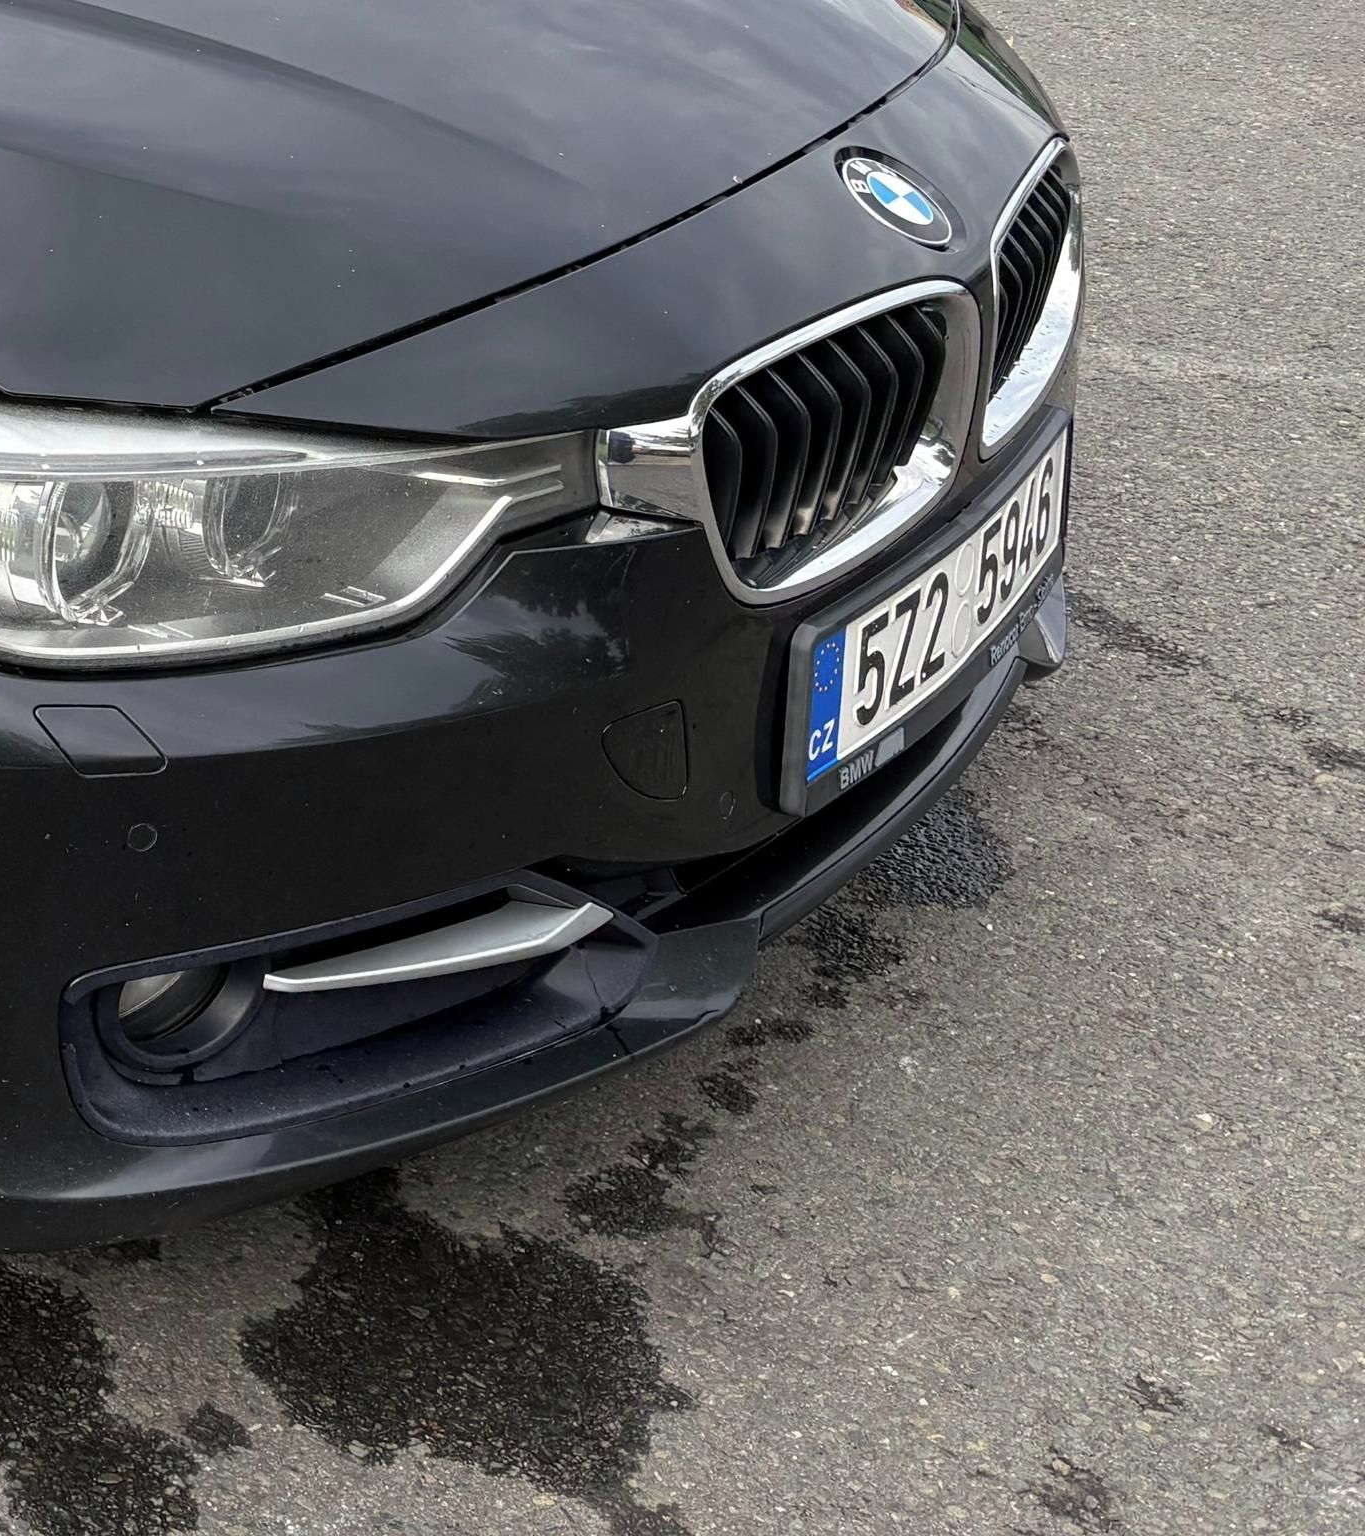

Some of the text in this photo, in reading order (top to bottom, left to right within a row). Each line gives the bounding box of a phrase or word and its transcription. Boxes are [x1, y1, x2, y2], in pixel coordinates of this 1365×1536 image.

[854, 457, 1054, 726] 5Z2 5946
[808, 716, 836, 761] CZ
[838, 749, 875, 790] BMW
